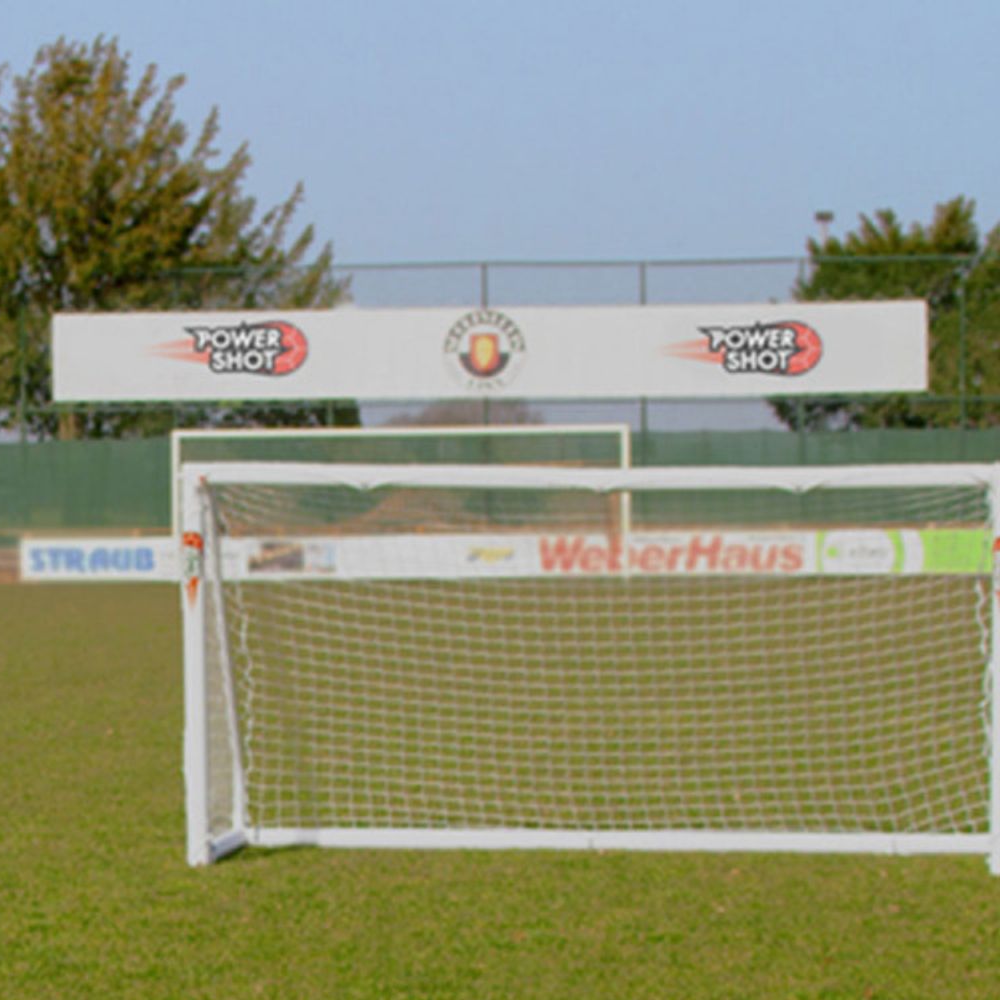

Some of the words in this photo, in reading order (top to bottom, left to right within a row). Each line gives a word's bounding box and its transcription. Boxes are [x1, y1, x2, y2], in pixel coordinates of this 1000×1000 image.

[193, 327, 282, 351] POWER
[709, 327, 797, 351] POWER
[211, 350, 277, 371] SHOT
[726, 350, 794, 371] SHOT
[29, 545, 155, 573] STRAUB
[538, 533, 805, 573] WeberHaus
